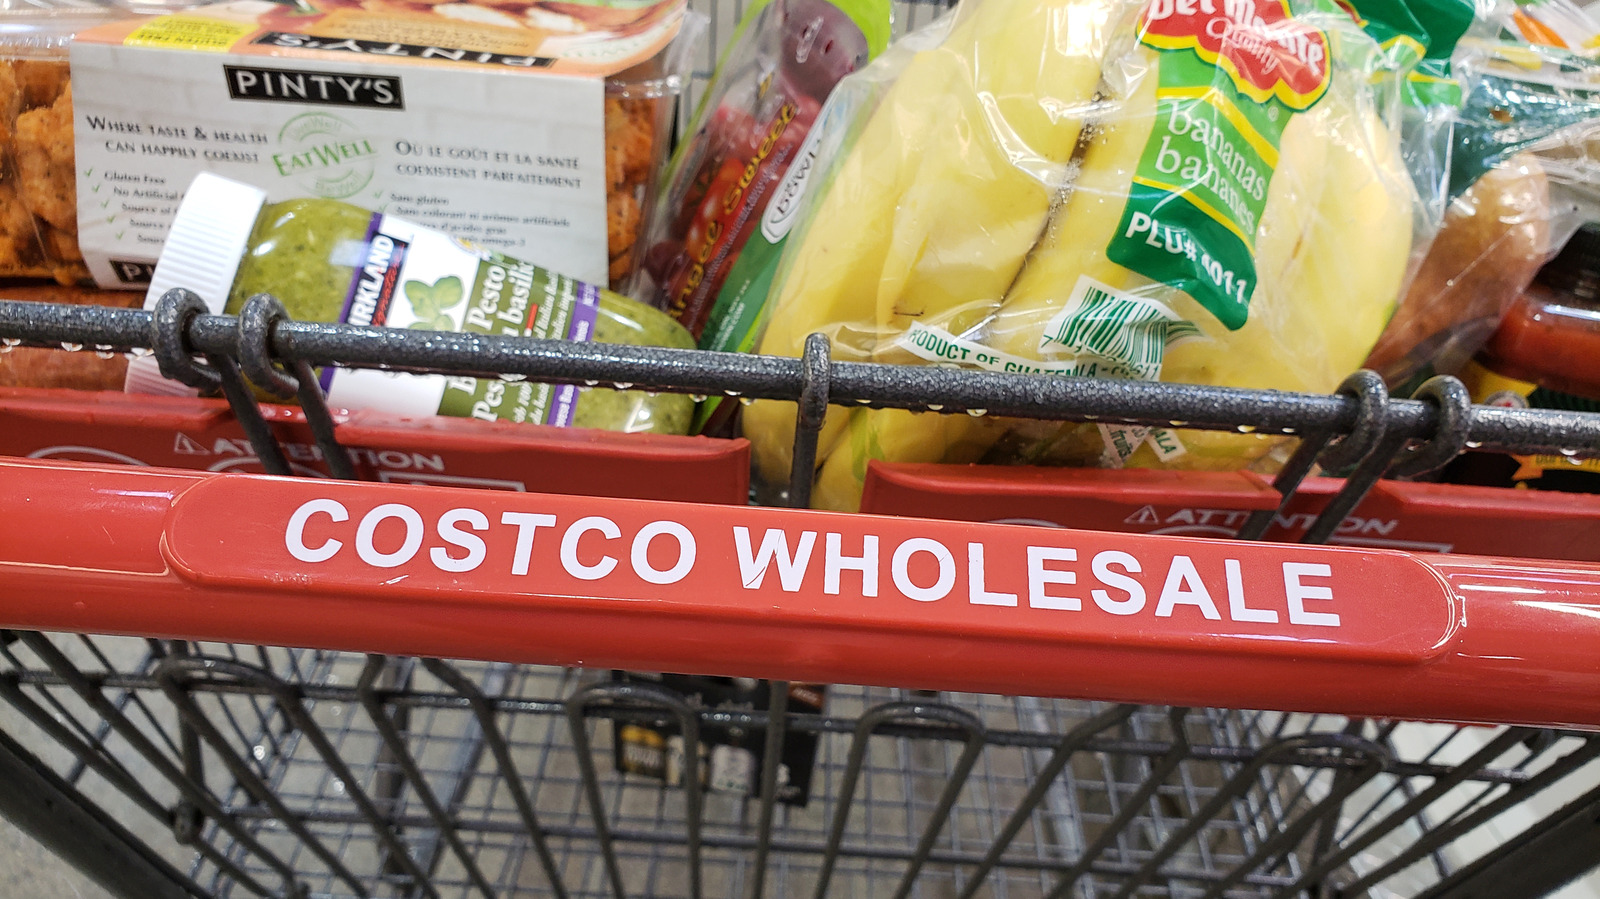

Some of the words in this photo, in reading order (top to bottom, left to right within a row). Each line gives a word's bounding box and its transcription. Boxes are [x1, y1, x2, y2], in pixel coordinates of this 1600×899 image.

[274, 34, 536, 67] PINTY'S
[235, 70, 395, 104] PINTY'S
[149, 124, 188, 138] TASTE
[194, 126, 207, 140] &
[213, 131, 268, 143] HEALTH
[105, 140, 136, 152] CAN
[141, 143, 197, 157] HAPPILY
[203, 150, 259, 162] COEXIST
[429, 146, 442, 158] LE
[495, 152, 510, 163] ET
[516, 154, 533, 165] LA
[724, 103, 797, 216] Sweet
[1167, 101, 1267, 201] bananas
[104, 170, 141, 182] Gluten
[144, 173, 166, 184] Free
[113, 186, 130, 197] No
[133, 188, 178, 200] Artificial
[396, 163, 478, 180] COEXISTENT
[483, 170, 582, 190] PARFAITEMENT
[1155, 136, 1256, 236] bananes
[137, 234, 165, 244] Sourc
[468, 264, 507, 331] Pesto
[908, 328, 971, 361] RODUCT
[976, 353, 1000, 366] OF
[472, 381, 506, 422] Pes
[213, 438, 445, 471] ATETION
[1165, 508, 1399, 536] ATTNTON
[284, 498, 697, 586] COSTCO
[733, 525, 1341, 627] WHOLESALE
